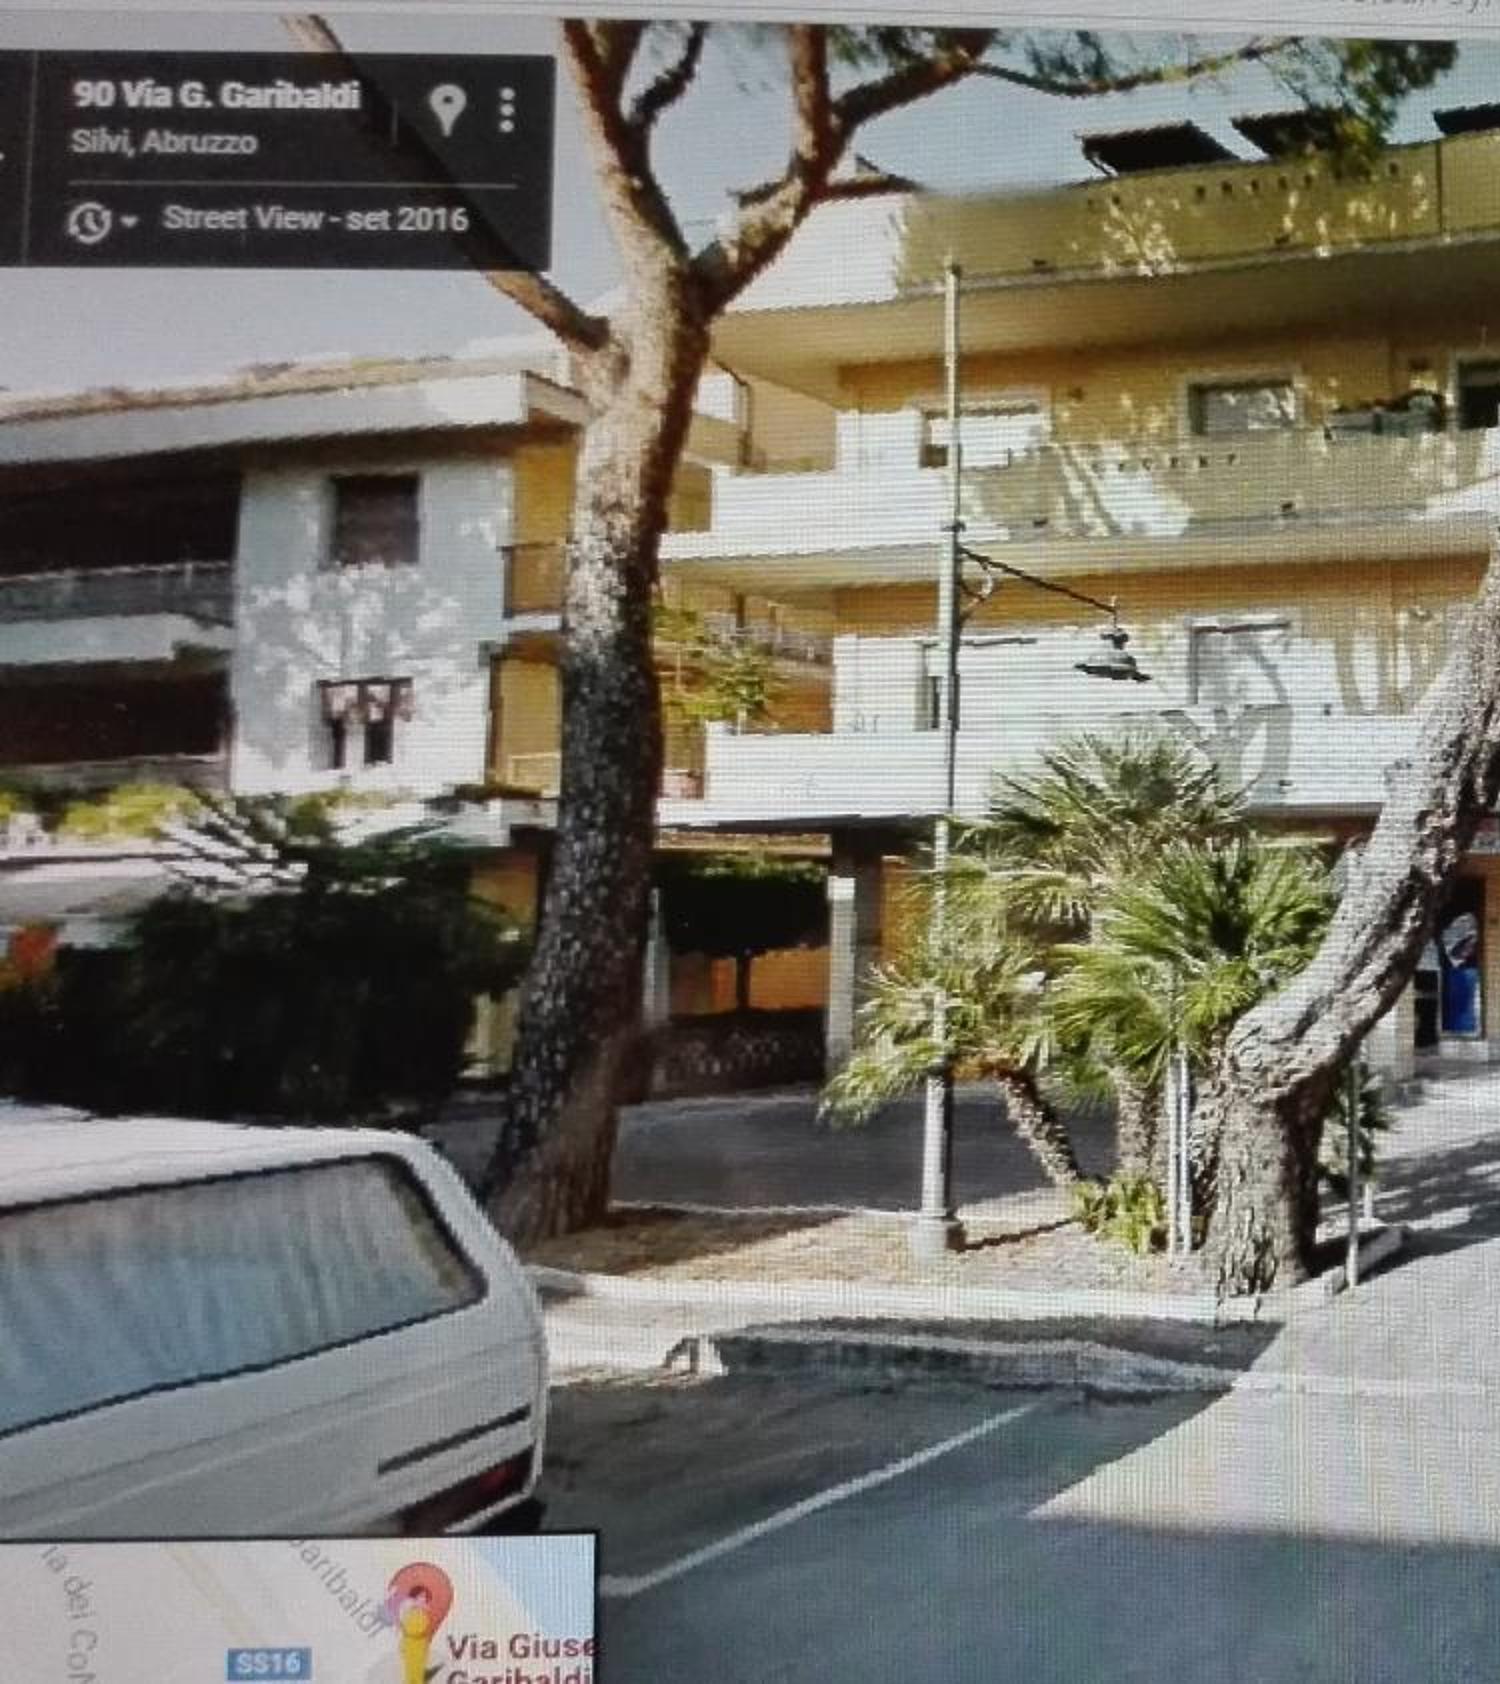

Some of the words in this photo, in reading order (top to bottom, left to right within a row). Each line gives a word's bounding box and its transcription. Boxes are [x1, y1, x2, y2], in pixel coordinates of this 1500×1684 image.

[72, 79, 116, 108] 90
[121, 77, 173, 108] Via
[179, 80, 213, 109] G.
[219, 78, 361, 110] Garibaldi
[71, 127, 135, 158] Silvi,
[143, 128, 259, 155] Abruzzo
[163, 204, 248, 231] Street
[254, 205, 325, 231] View
[346, 207, 392, 232] set
[397, 206, 470, 233] 2016
[447, 1632, 498, 1660] Via
[235, 1651, 302, 1676] SS16
